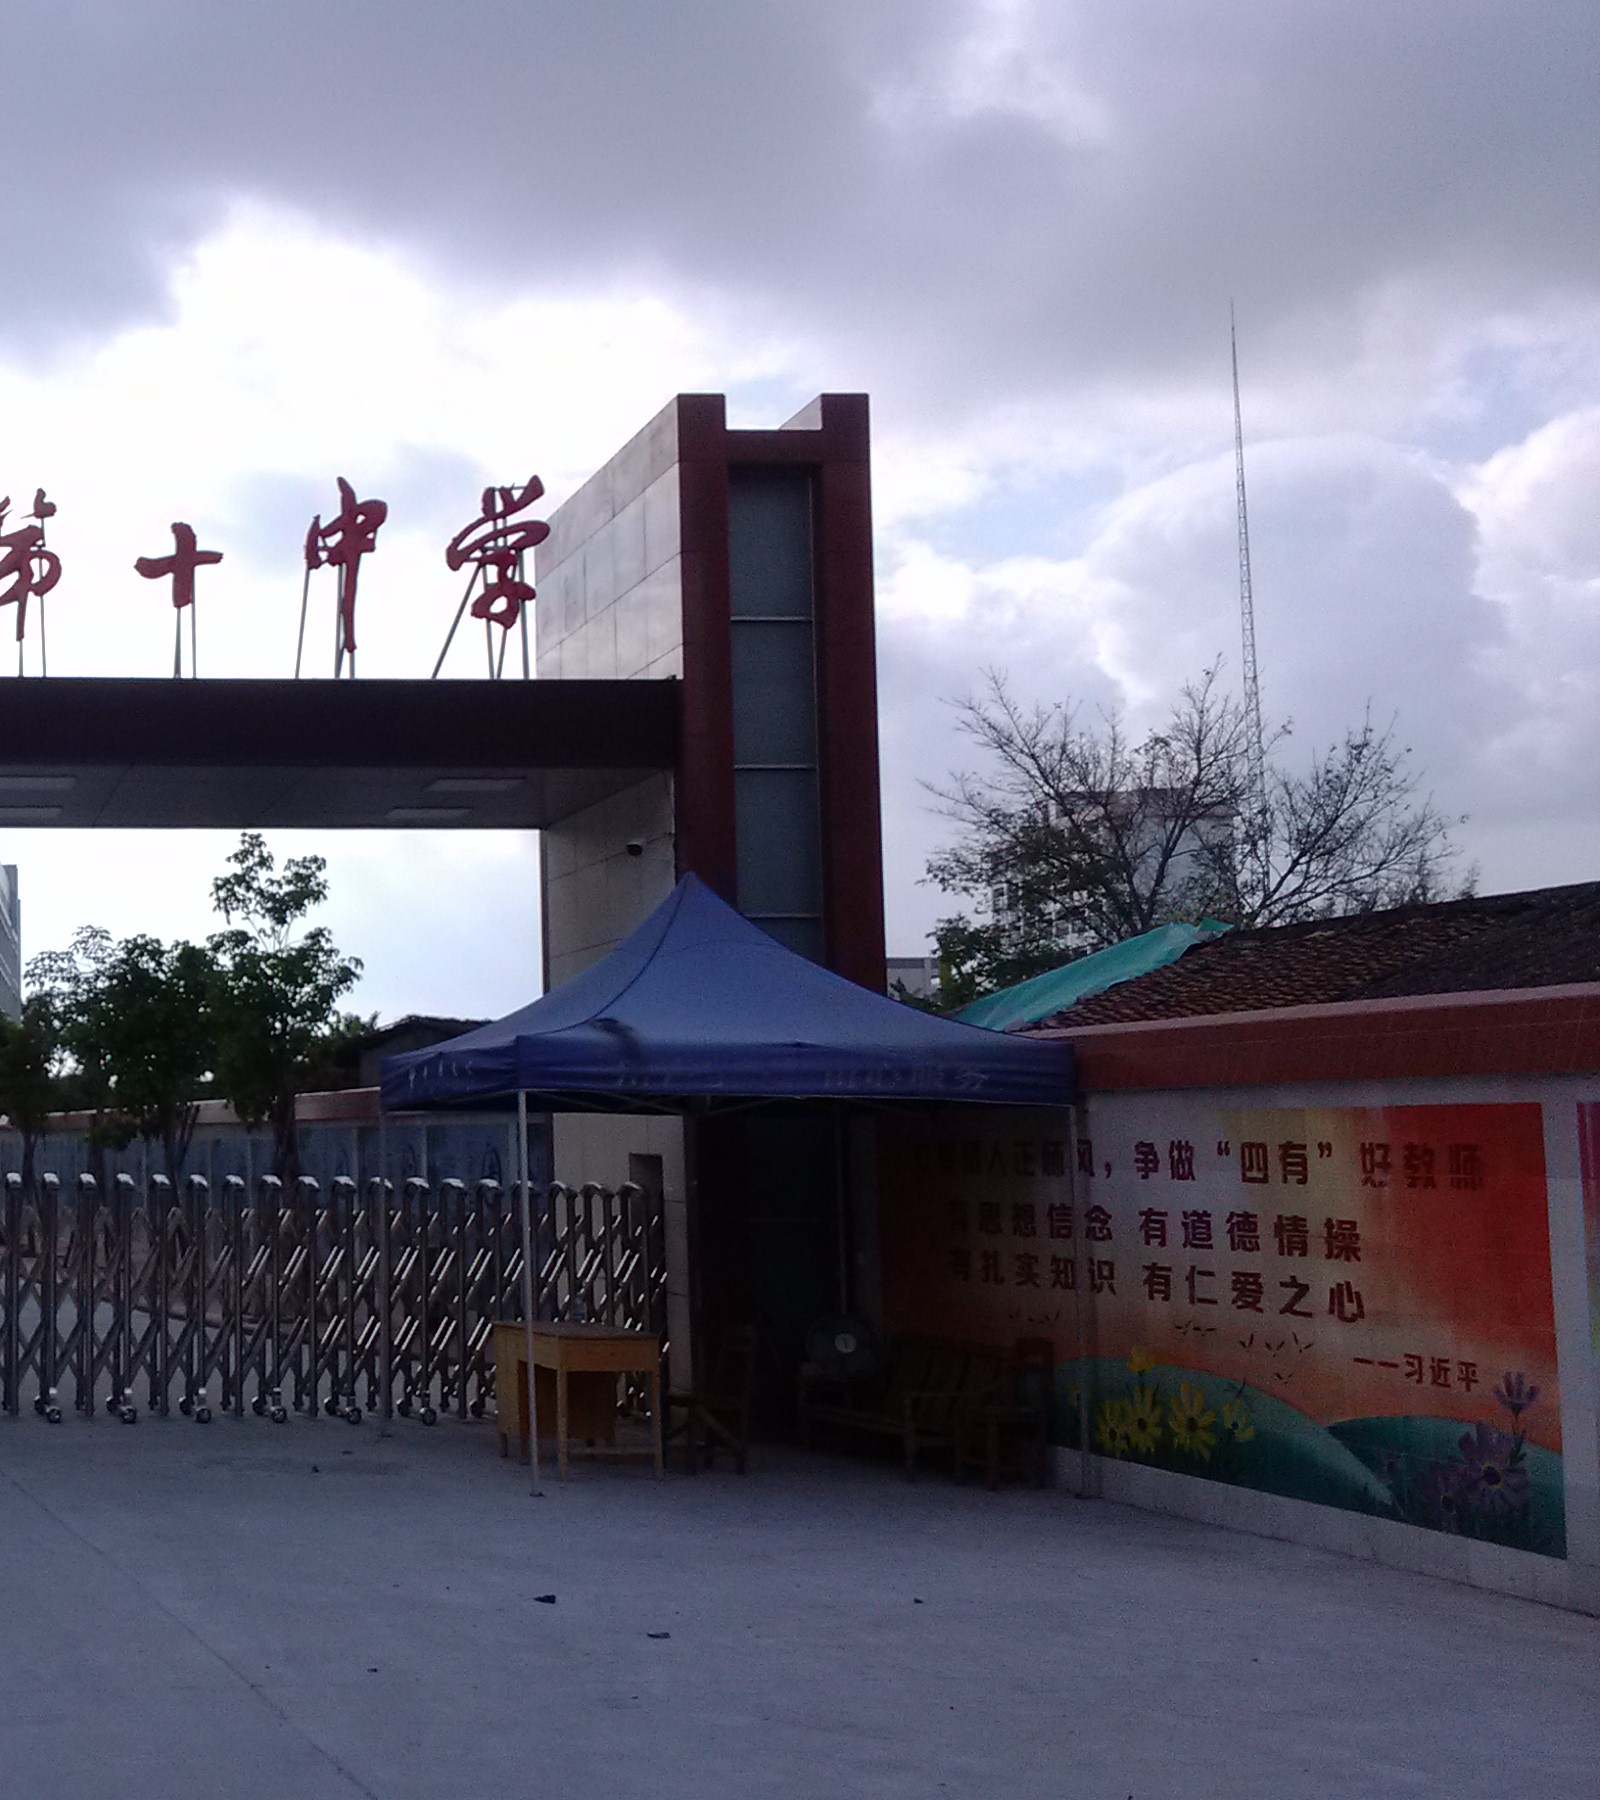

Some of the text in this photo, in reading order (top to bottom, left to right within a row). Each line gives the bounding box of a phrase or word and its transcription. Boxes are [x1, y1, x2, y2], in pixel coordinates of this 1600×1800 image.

[1137, 1206, 1362, 1264] 有道德情操
[1141, 1261, 1366, 1325] 有仁爱之心
